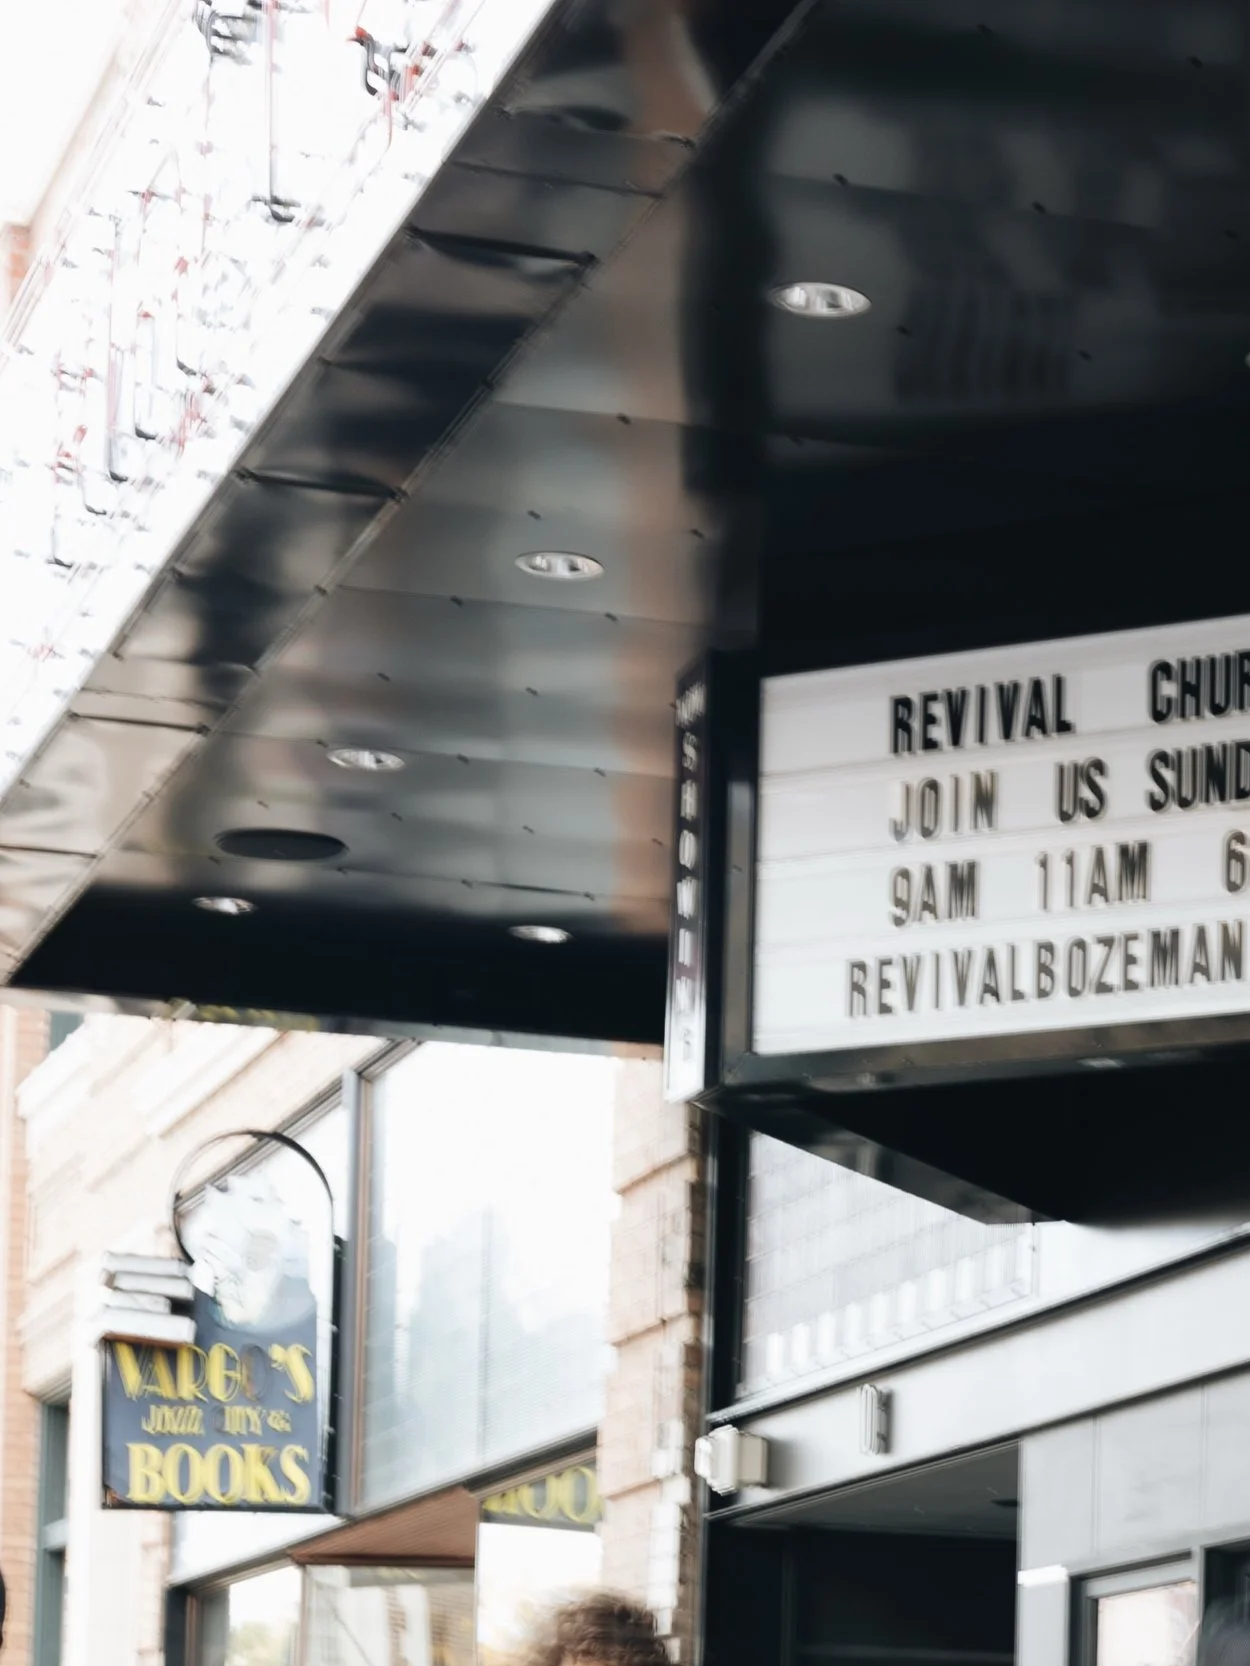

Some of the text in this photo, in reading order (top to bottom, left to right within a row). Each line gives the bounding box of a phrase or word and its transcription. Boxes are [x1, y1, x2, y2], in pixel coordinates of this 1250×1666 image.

[890, 673, 1074, 756] REVIVAL
[888, 769, 998, 843] JOIN
[1055, 757, 1109, 823] US
[889, 859, 980, 928] 9AM
[1036, 840, 1151, 912] 11AM
[125, 1442, 312, 1506] BOOKS
